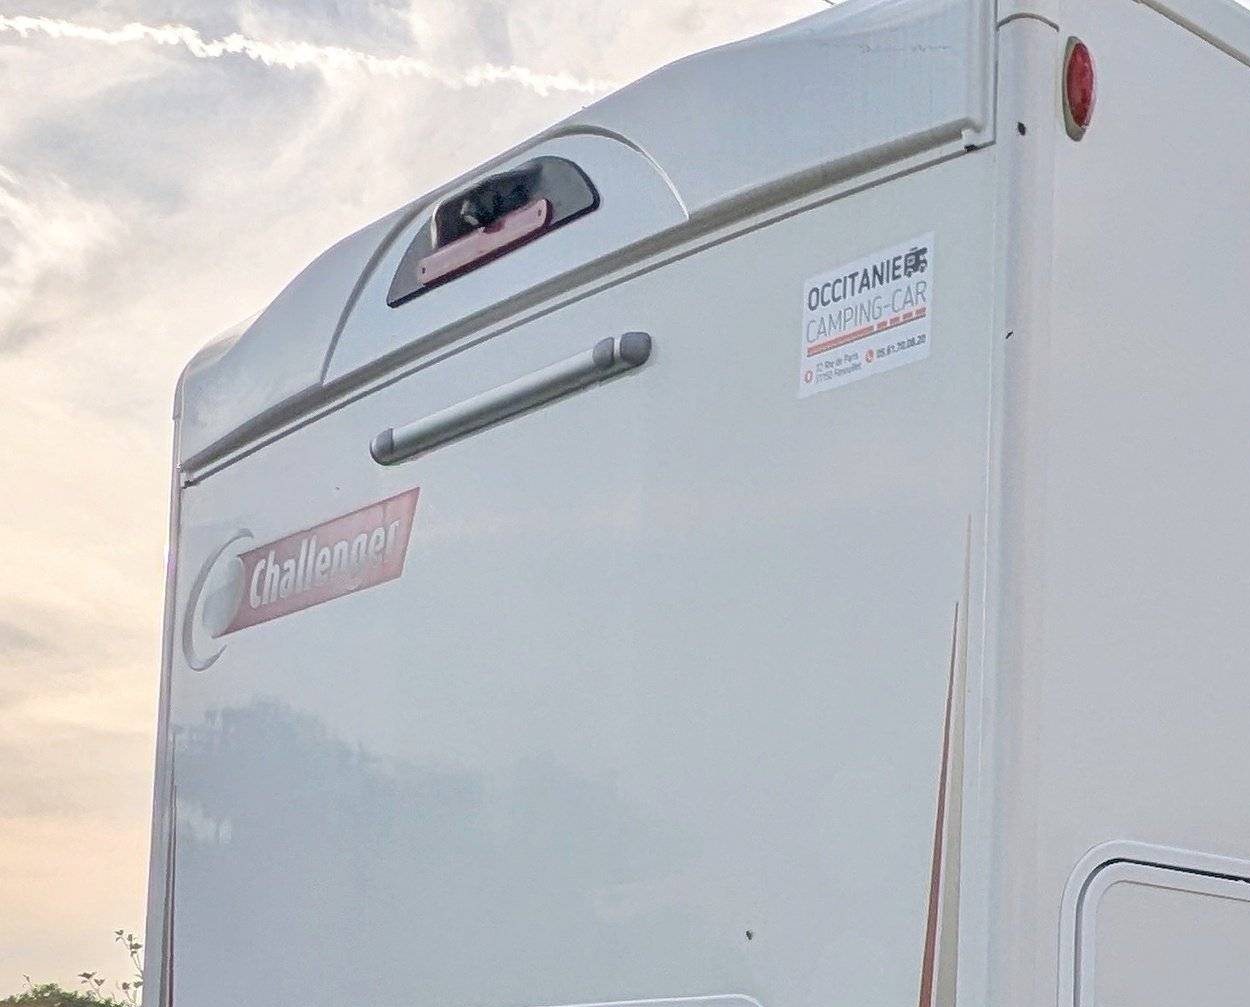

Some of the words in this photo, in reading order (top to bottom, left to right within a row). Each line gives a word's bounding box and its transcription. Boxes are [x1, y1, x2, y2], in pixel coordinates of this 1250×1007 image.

[806, 280, 928, 343] CAMPING-CAR
[807, 255, 903, 311] OCCITANIE
[249, 519, 402, 610] Challenger
